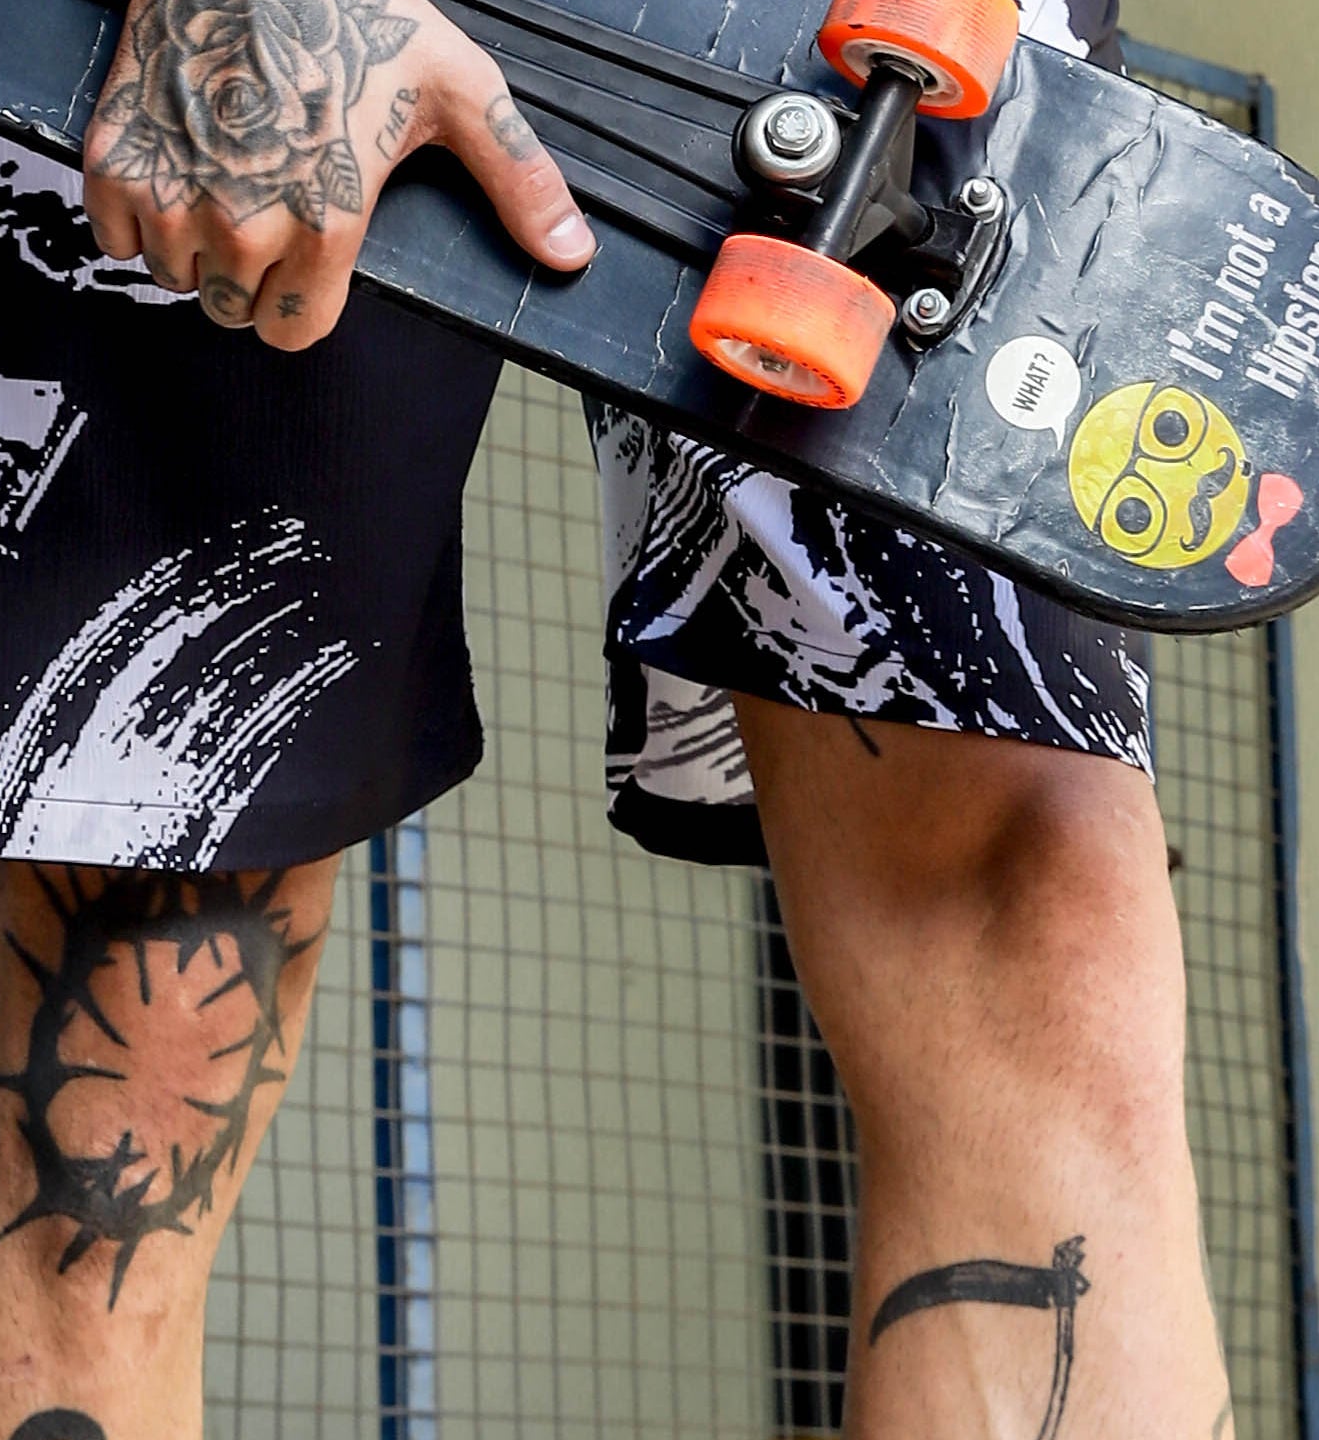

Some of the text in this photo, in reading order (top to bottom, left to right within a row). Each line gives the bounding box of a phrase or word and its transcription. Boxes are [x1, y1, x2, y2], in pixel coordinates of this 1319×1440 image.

[1166, 192, 1292, 381] I'm not a
[1012, 353, 1055, 412] WHAT?
